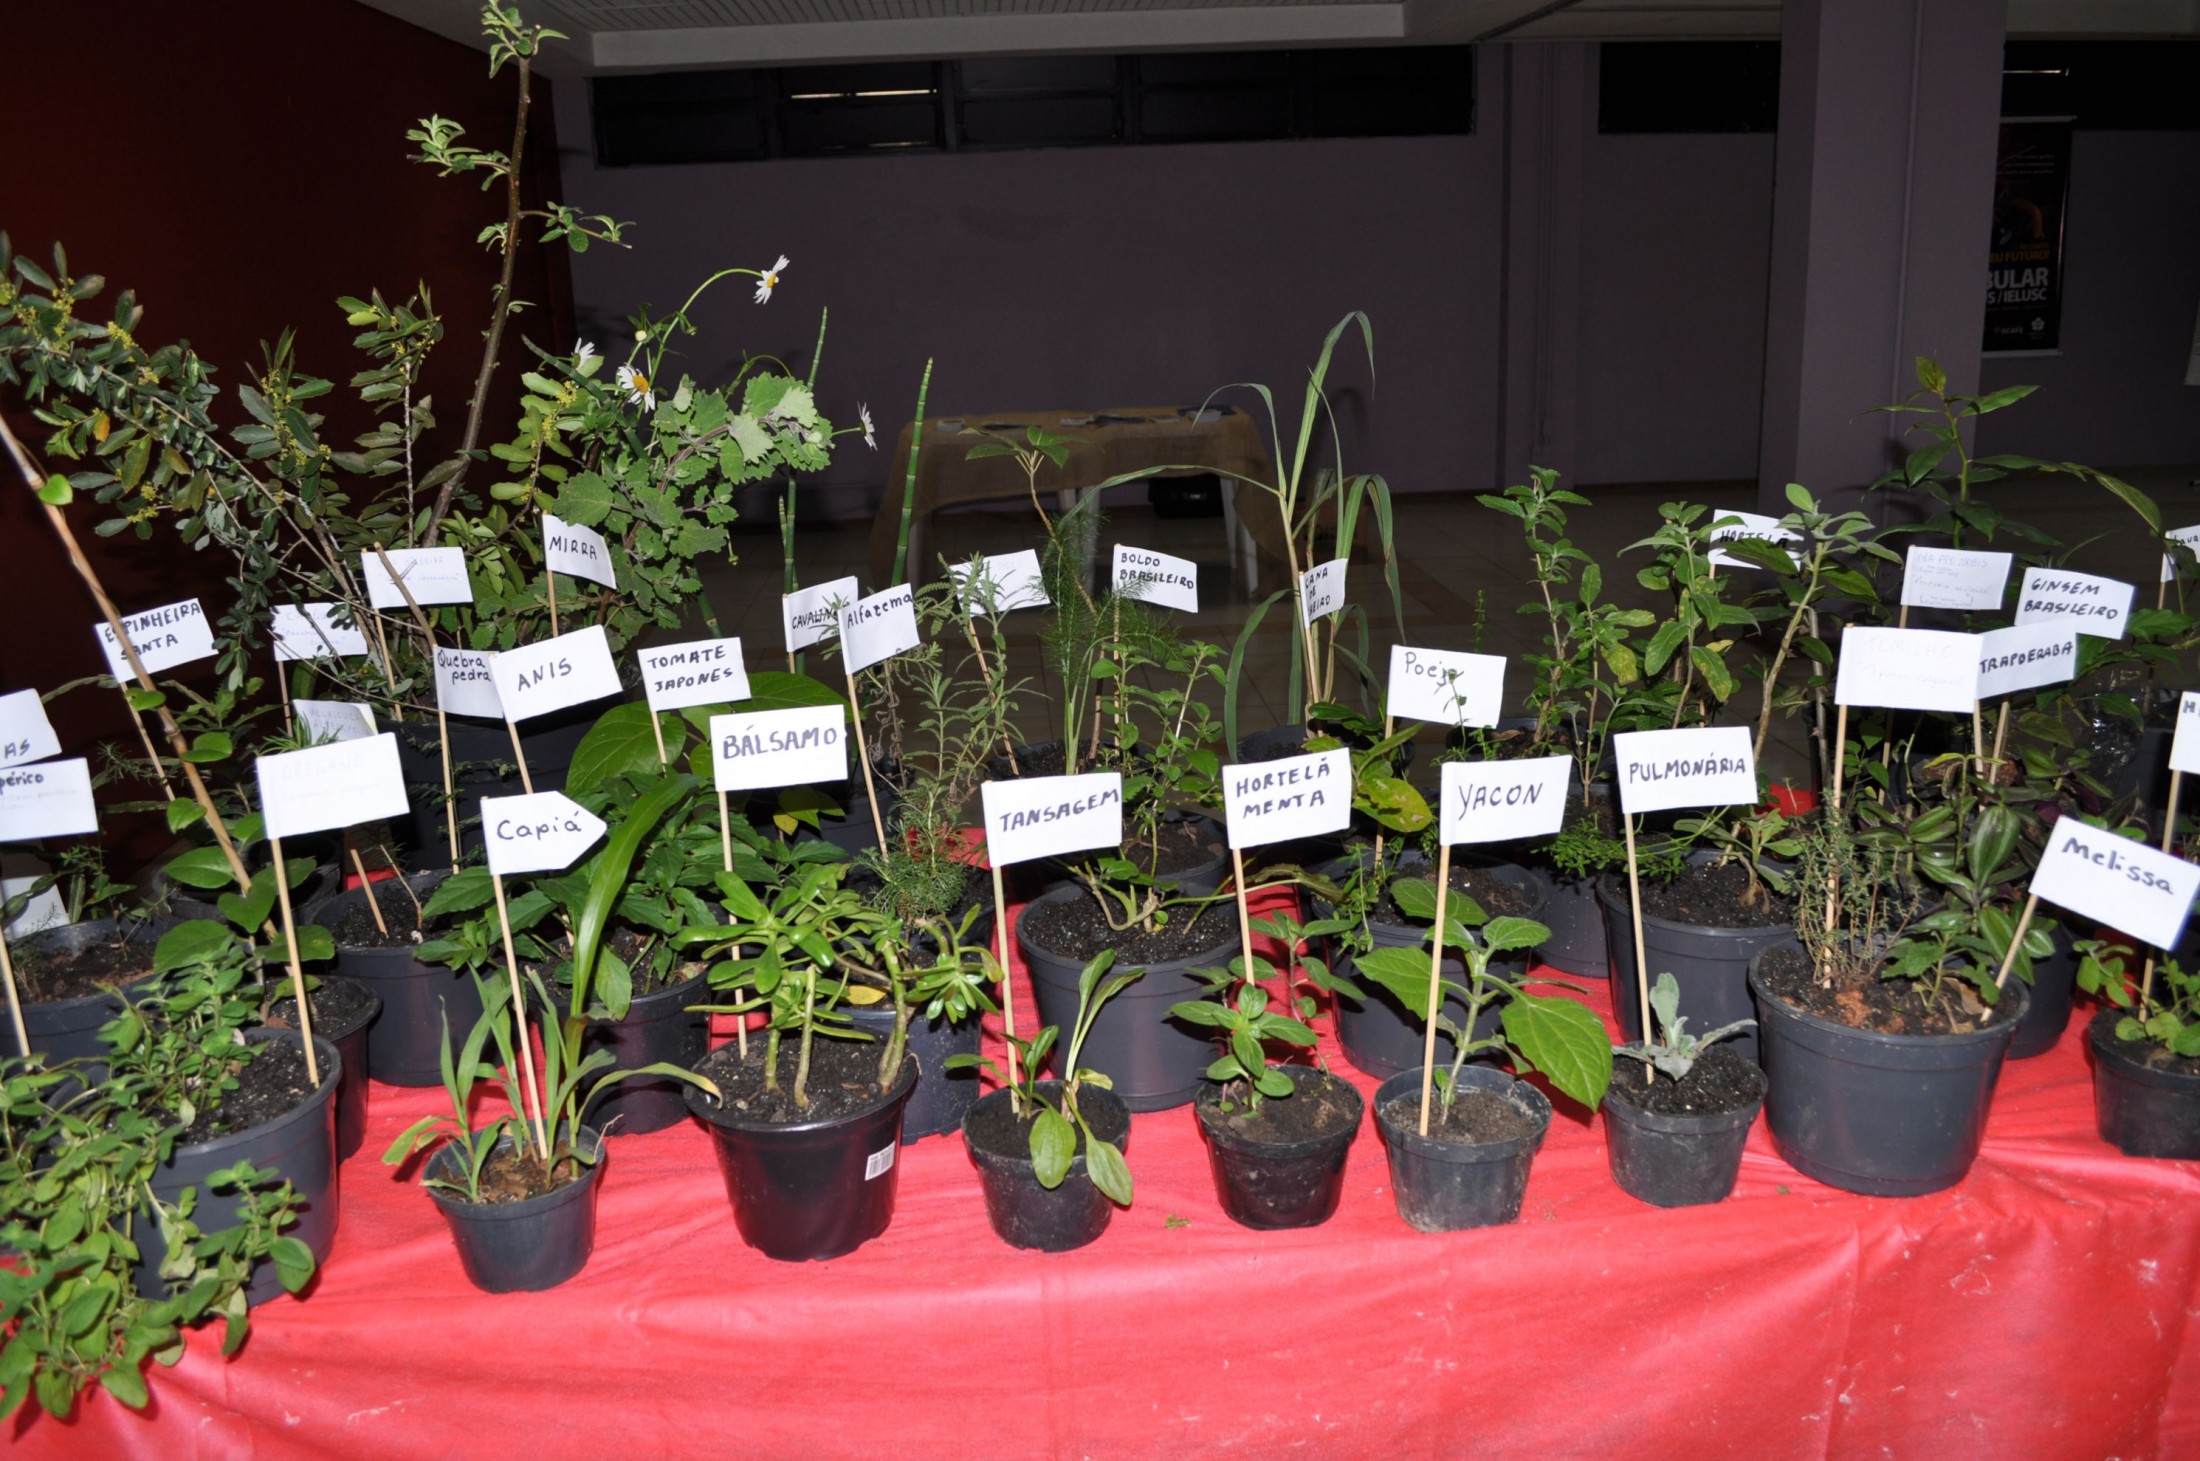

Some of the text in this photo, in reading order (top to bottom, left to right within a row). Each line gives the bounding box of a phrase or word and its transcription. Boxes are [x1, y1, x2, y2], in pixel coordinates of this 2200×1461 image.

[2004, 288, 2047, 303] IELUSC
[548, 535, 597, 560] MIRRA
[1120, 552, 1160, 567] BOLDO
[1119, 568, 1194, 590] BRASILEIRO
[2031, 577, 2099, 596] GINSEM
[104, 601, 201, 644] EPINHEIRA
[2024, 598, 2119, 621] BRASILEIRO
[437, 650, 487, 670] Quebra
[647, 642, 726, 669] TOMATE
[1979, 641, 2073, 675] TRAPOERABA
[451, 665, 492, 685] pedra
[517, 657, 573, 692] ANIS
[655, 667, 734, 693] JAPONES
[723, 724, 839, 760] BÁLSAMO
[1235, 756, 1332, 798] HORTELÃ
[1629, 752, 1746, 784] PULMONÁRIA
[1000, 788, 1120, 833] TANSAGEM
[1242, 789, 1326, 819] MENTA
[1458, 782, 1543, 821] YACON
[496, 809, 583, 841] Capiá
[2061, 837, 2174, 896] Melissa
